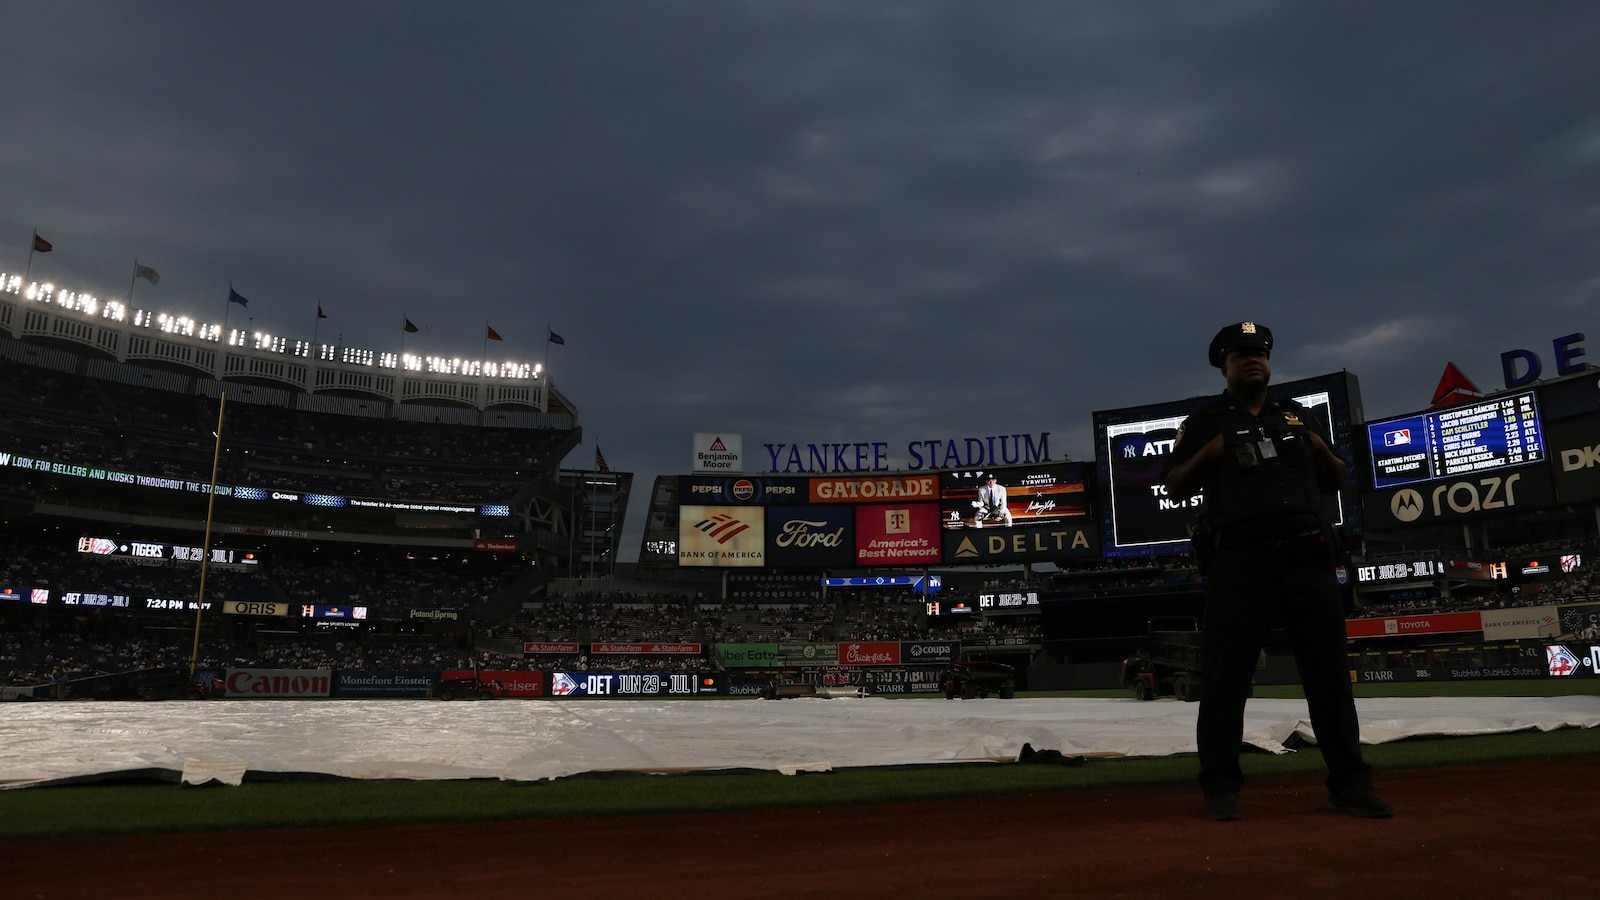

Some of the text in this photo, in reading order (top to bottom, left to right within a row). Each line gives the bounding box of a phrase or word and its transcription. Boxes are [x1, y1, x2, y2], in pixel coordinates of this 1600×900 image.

[1441, 419, 1459, 429] JACOB
[1442, 428, 1454, 436] CAM
[1454, 421, 1489, 434] SCHLITTLER
[1522, 411, 1535, 420] NYY
[1442, 434, 1461, 443] CHASE
[1443, 442, 1460, 451] CHRIS
[1461, 439, 1476, 448] SALE
[1525, 427, 1537, 436] ATL
[763, 432, 1052, 473] YANKEE STADIUM
[1444, 450, 1459, 459] NICK
[1459, 444, 1488, 456] MARTINEZ
[1526, 436, 1535, 444] TB
[698, 451, 738, 463] Benjamin
[1377, 453, 1426, 467] STARTING PITCHER
[1446, 457, 1468, 466] PARKER
[1469, 452, 1494, 462] MESSICK
[1527, 443, 1539, 452] CLE
[703, 459, 731, 469] Moore
[1396, 462, 1420, 472] LEADERS
[1447, 464, 1473, 474] EDUARDO
[1473, 457, 1506, 470] RODRIGUEZ
[1528, 452, 1537, 460] AZ
[12, 456, 34, 469] LOOK
[35, 460, 50, 471] FOR
[53, 462, 87, 478] SELLERS
[89, 468, 105, 480] AND
[107, 470, 135, 484] KIOSKS
[137, 475, 184, 491] THROUGHOUT
[186, 482, 199, 492] THE
[817, 478, 934, 499] GATORADE
[1021, 478, 1057, 486] TYRWHITT
[691, 485, 723, 495] PEPSI
[765, 485, 796, 495] PEPSI
[1432, 473, 1521, 517] razr
[423, 504, 439, 512] spend
[776, 518, 845, 548] Ford
[868, 537, 928, 549] America's
[988, 530, 1090, 555] DELTA
[131, 543, 234, 564] TIGERS JUN 29 JUL 1
[721, 551, 763, 559] AMERICA
[858, 546, 939, 558] Best Network
[1358, 566, 1376, 581] DET
[65, 592, 81, 605] DET
[147, 598, 167, 609] 7:24
[168, 599, 184, 609] PM
[980, 594, 995, 607] DET
[235, 602, 276, 615] ORIS
[410, 608, 458, 621] Poland Spring
[1400, 620, 1431, 629] TOYOTA
[847, 648, 892, 663] Chick-fil-A
[923, 645, 950, 656] coupa
[1364, 670, 1394, 681] STARR
[1451, 666, 1541, 678] StubHub StubHub StubHub
[227, 671, 323, 694] Canon
[340, 675, 393, 685] Montefiore
[587, 675, 613, 695] DET
[618, 675, 641, 694] JUN
[642, 675, 660, 694] 29
[669, 674, 690, 693] JUL
[692, 674, 698, 693] 1
[877, 684, 905, 693] STARR
